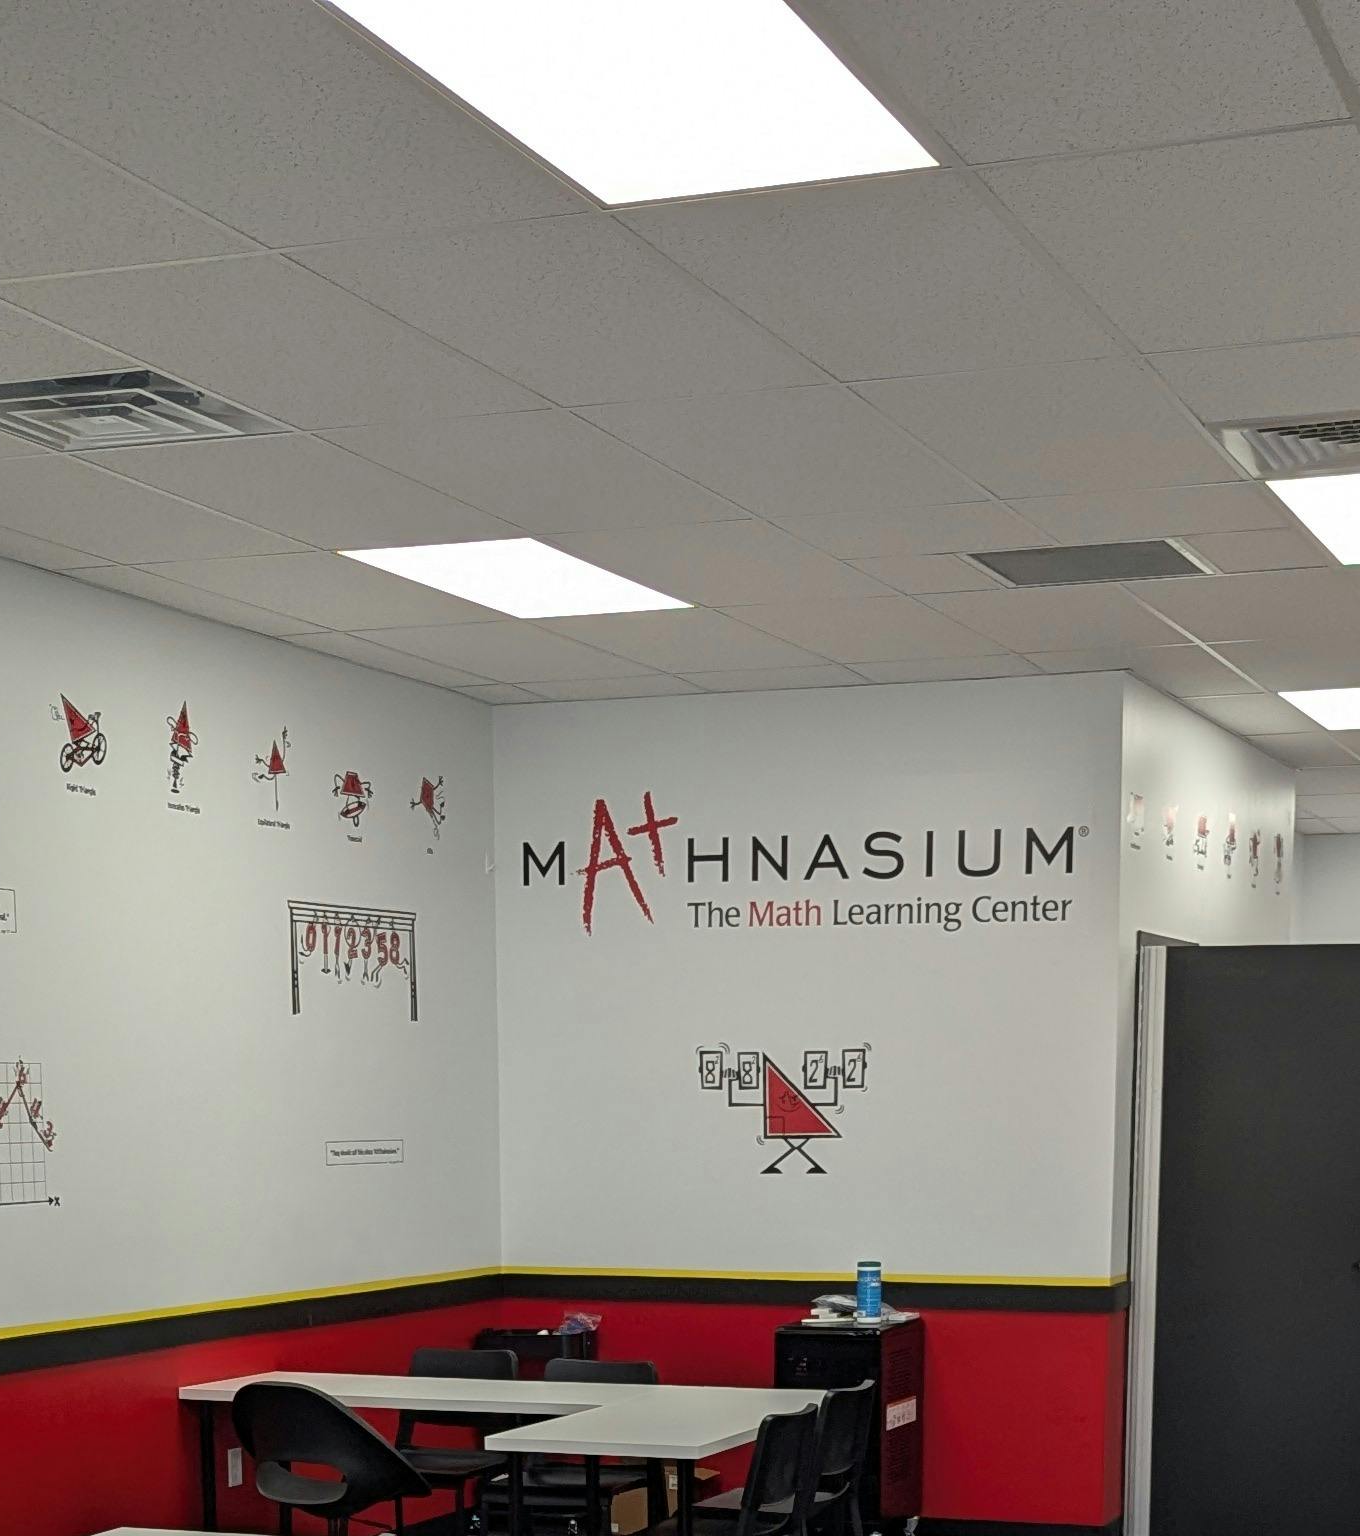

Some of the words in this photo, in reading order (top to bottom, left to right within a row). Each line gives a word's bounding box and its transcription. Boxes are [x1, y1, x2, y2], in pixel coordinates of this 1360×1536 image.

[687, 902, 740, 928] The
[748, 900, 822, 927] Math
[832, 896, 962, 931] Learning
[971, 895, 1072, 923] Center
